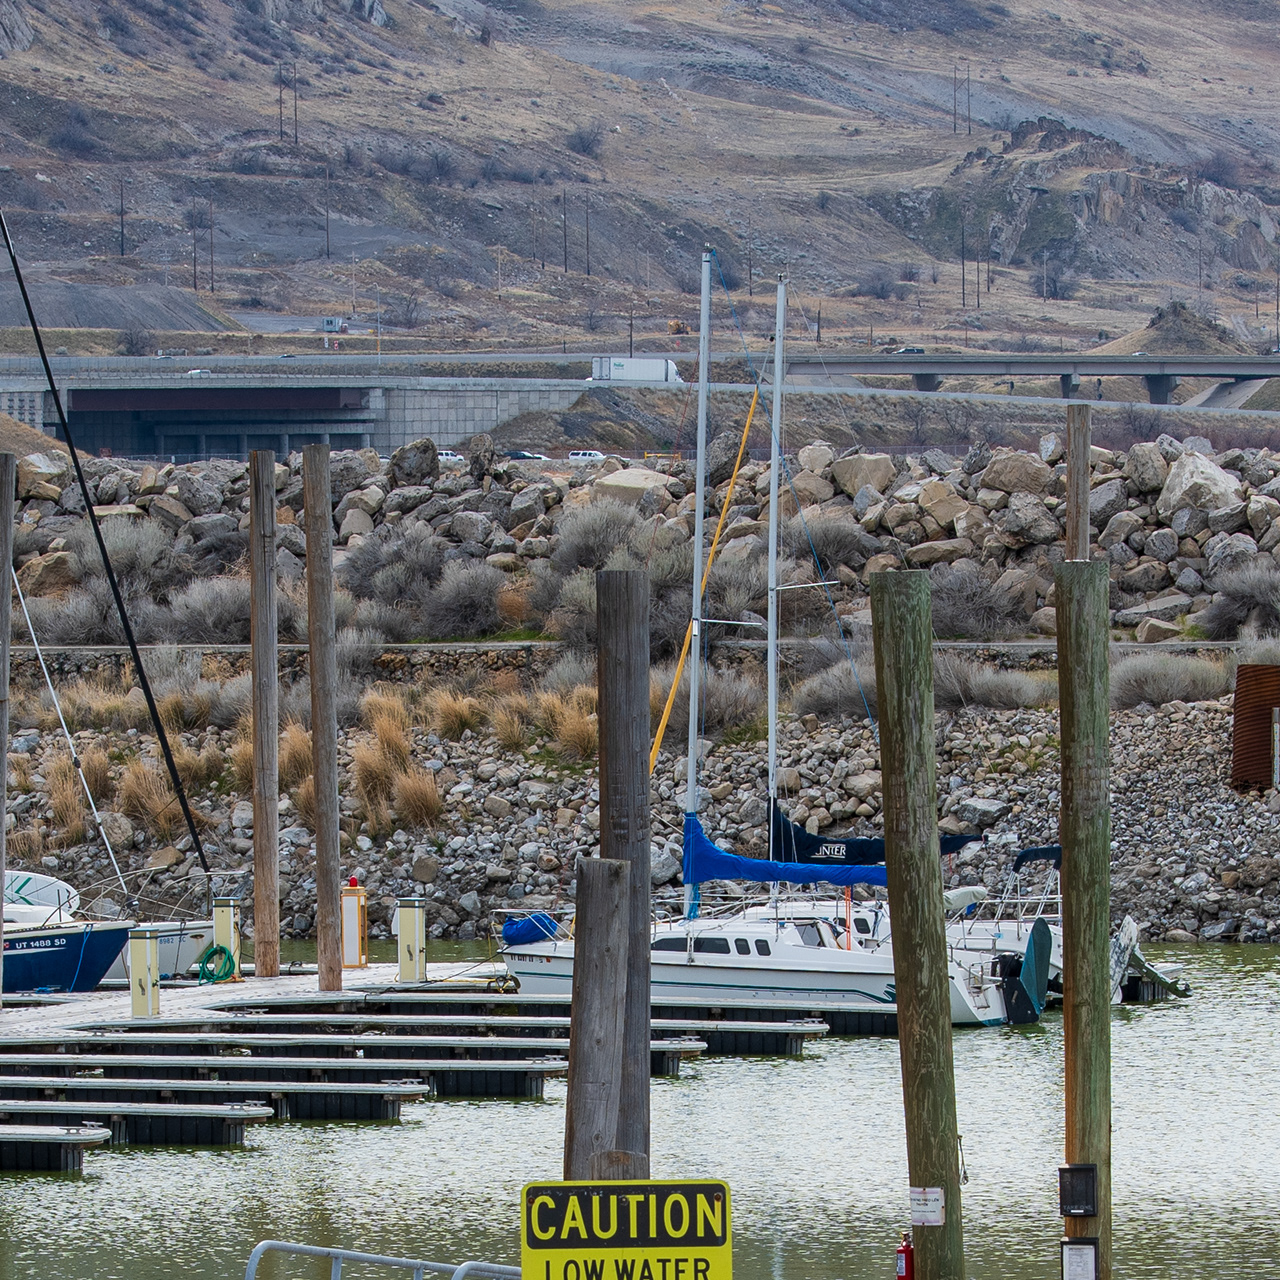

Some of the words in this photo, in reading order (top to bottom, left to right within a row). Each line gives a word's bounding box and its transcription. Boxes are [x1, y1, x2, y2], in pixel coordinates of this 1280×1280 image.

[15, 941, 28, 949] UT
[29, 940, 52, 948] 1488
[53, 938, 67, 946] SD
[530, 1192, 723, 1241] CAUTION
